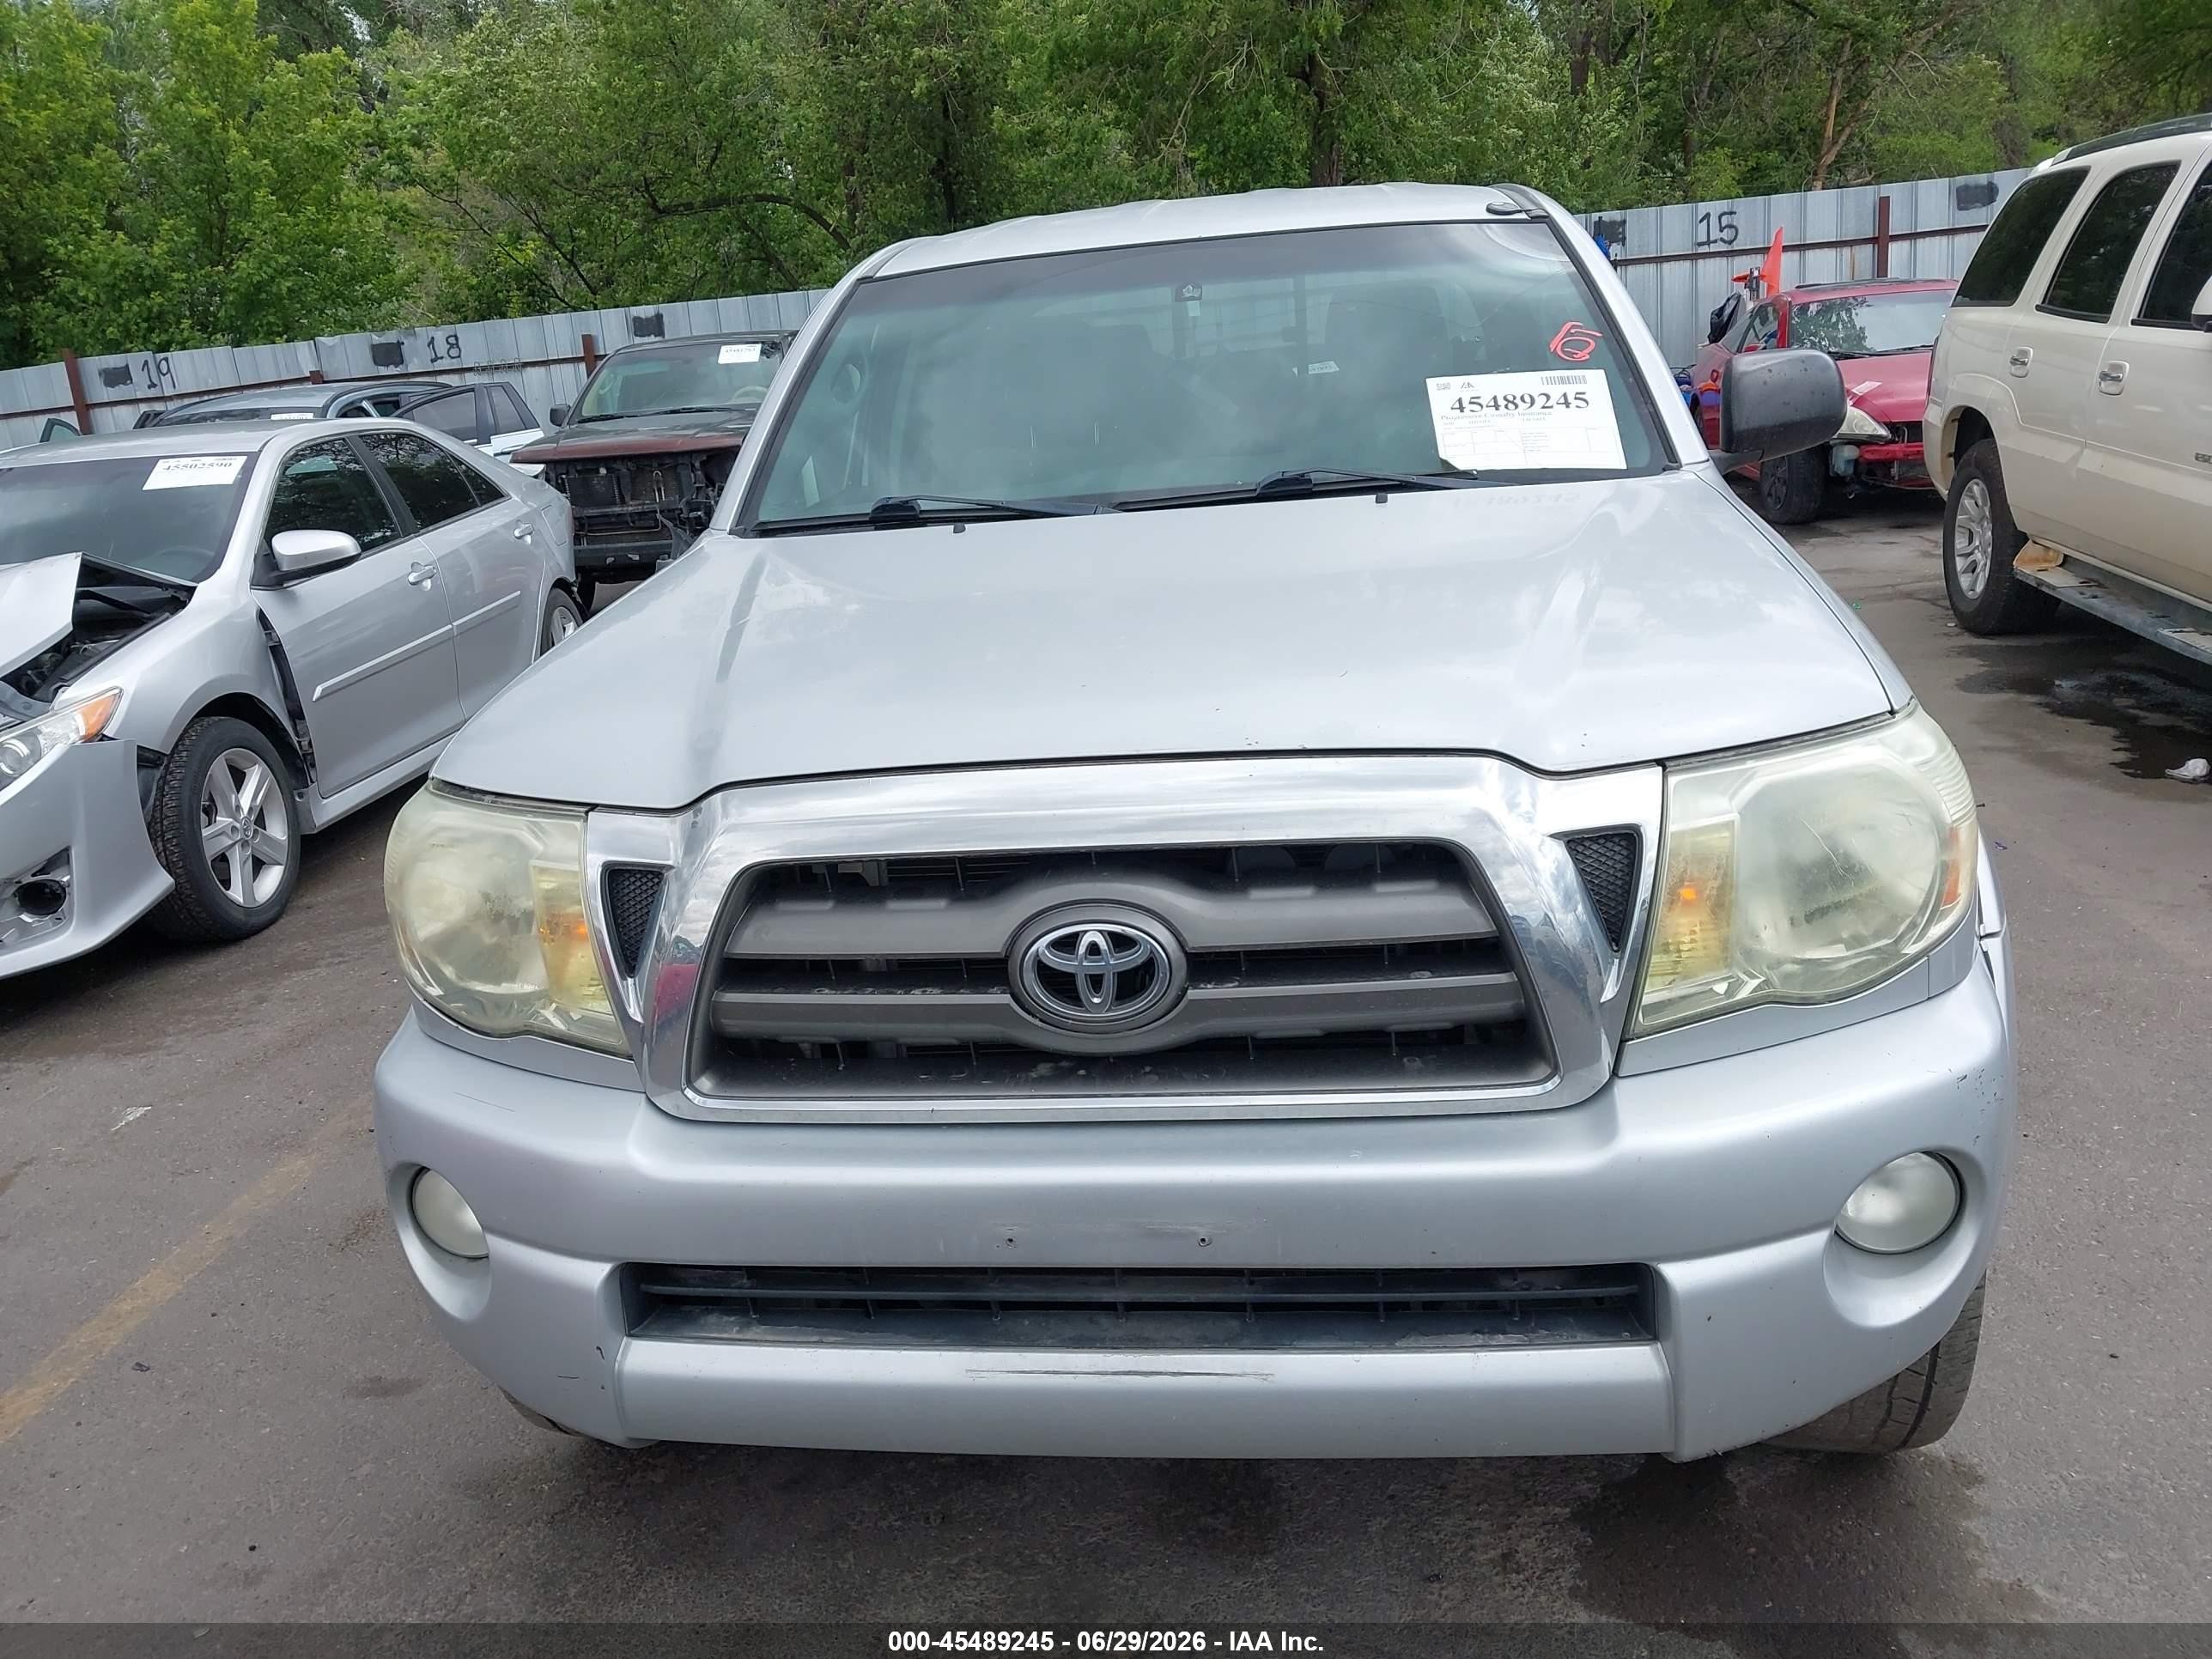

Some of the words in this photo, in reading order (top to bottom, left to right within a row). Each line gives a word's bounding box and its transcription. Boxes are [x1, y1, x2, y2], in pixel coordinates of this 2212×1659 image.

[1696, 211, 1739, 246] 15
[428, 334, 461, 363] 18
[141, 356, 176, 390] 19
[1450, 392, 1590, 413] 45489245
